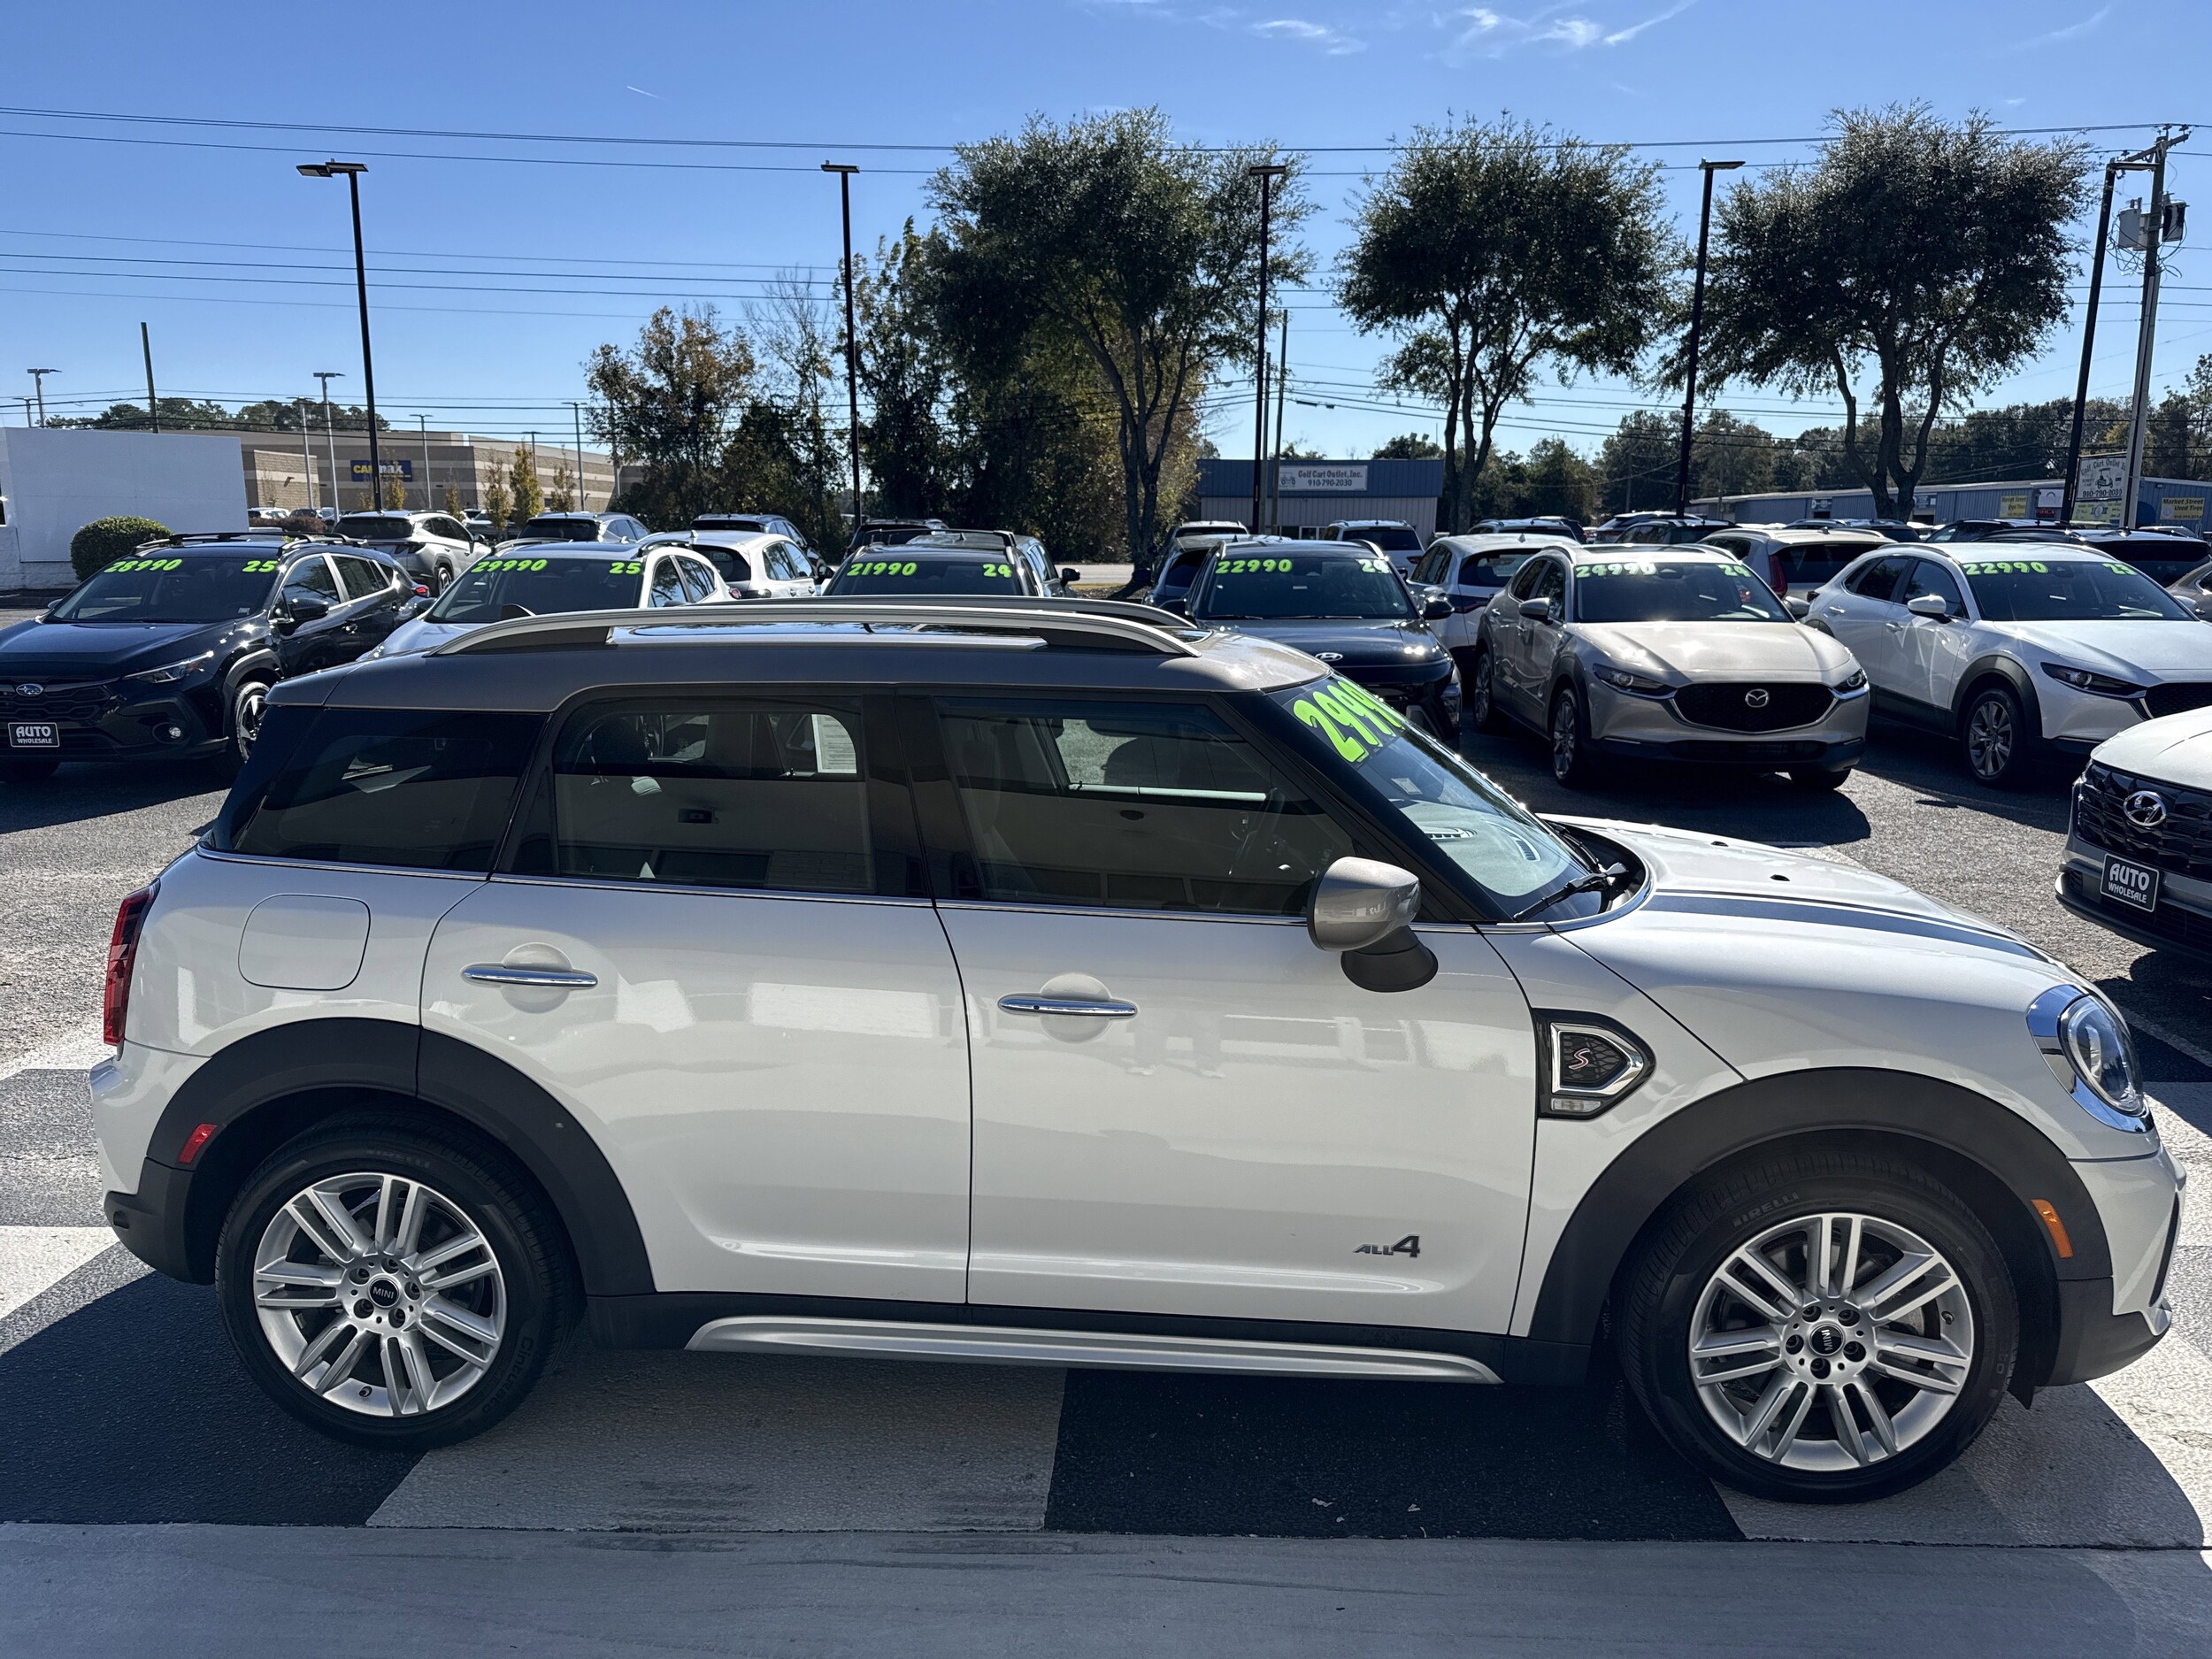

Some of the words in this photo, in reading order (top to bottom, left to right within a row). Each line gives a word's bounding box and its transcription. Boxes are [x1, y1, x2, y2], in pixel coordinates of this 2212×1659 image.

[2093, 460, 2104, 469] Cart
[104, 558, 182, 573] 28990
[242, 560, 279, 573] 25
[471, 558, 548, 573] 29990
[609, 562, 641, 575] 25
[846, 562, 918, 576] 21990
[982, 564, 1013, 578] 24
[1215, 558, 1293, 574] 22990
[1575, 563, 1657, 578] 24990
[1962, 561, 2048, 575] 22990
[1293, 677, 1407, 763] 2999
[16, 726, 51, 738] AUTO
[2109, 863, 2150, 891] AUTO
[2108, 881, 2147, 903] WHOLESALE
[1568, 1048, 1591, 1070] S
[1732, 1191, 1800, 1227] PIRELLI
[373, 1286, 395, 1300] MINI
[1821, 1329, 1833, 1351] MINI
